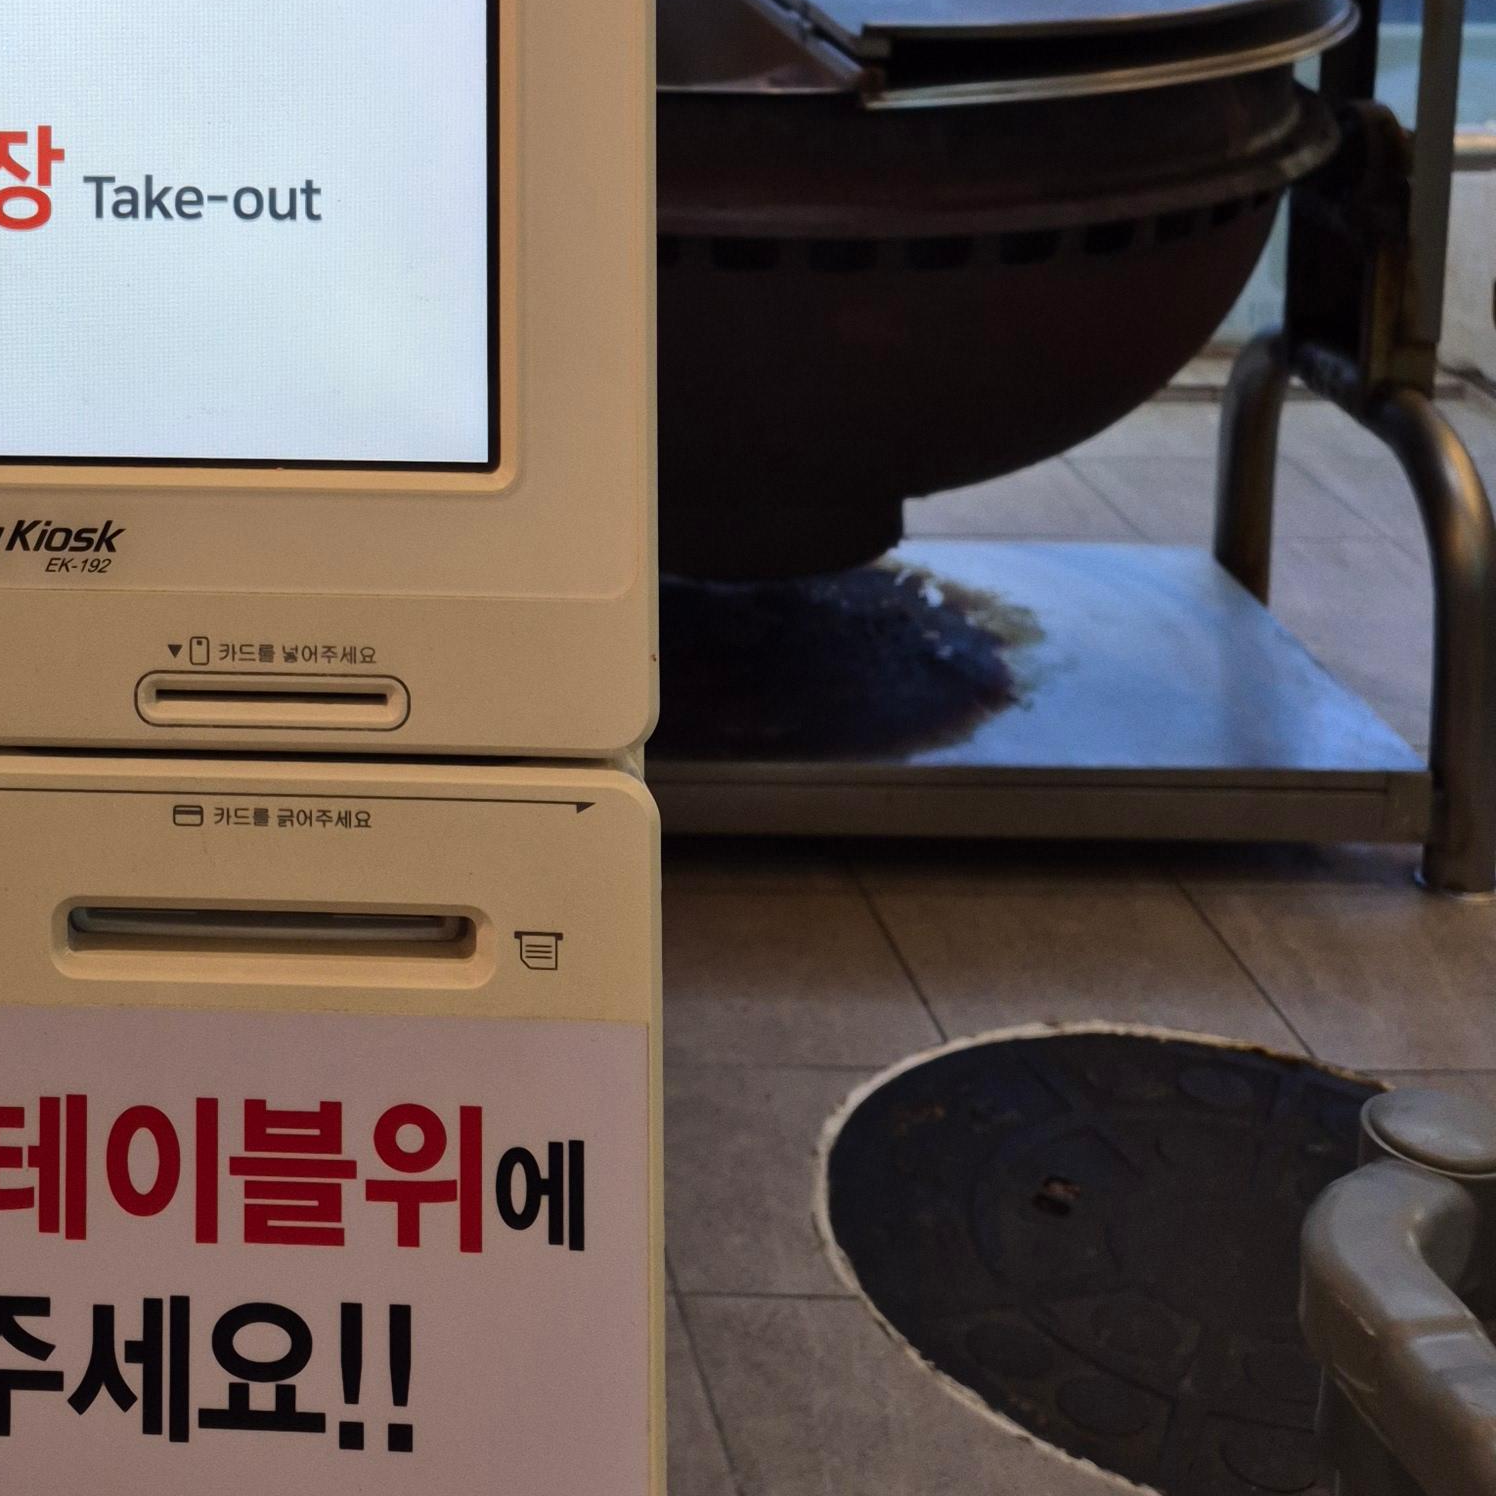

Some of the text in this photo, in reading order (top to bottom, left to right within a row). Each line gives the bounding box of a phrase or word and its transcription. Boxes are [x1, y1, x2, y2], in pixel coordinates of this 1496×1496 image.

[82, 173, 324, 222] Take-out
[5, 519, 126, 553] Kiosk
[44, 556, 112, 574] EK-192
[218, 643, 377, 665] 카드를 넣어주세요
[213, 807, 372, 829] 카드를 긁어주세요
